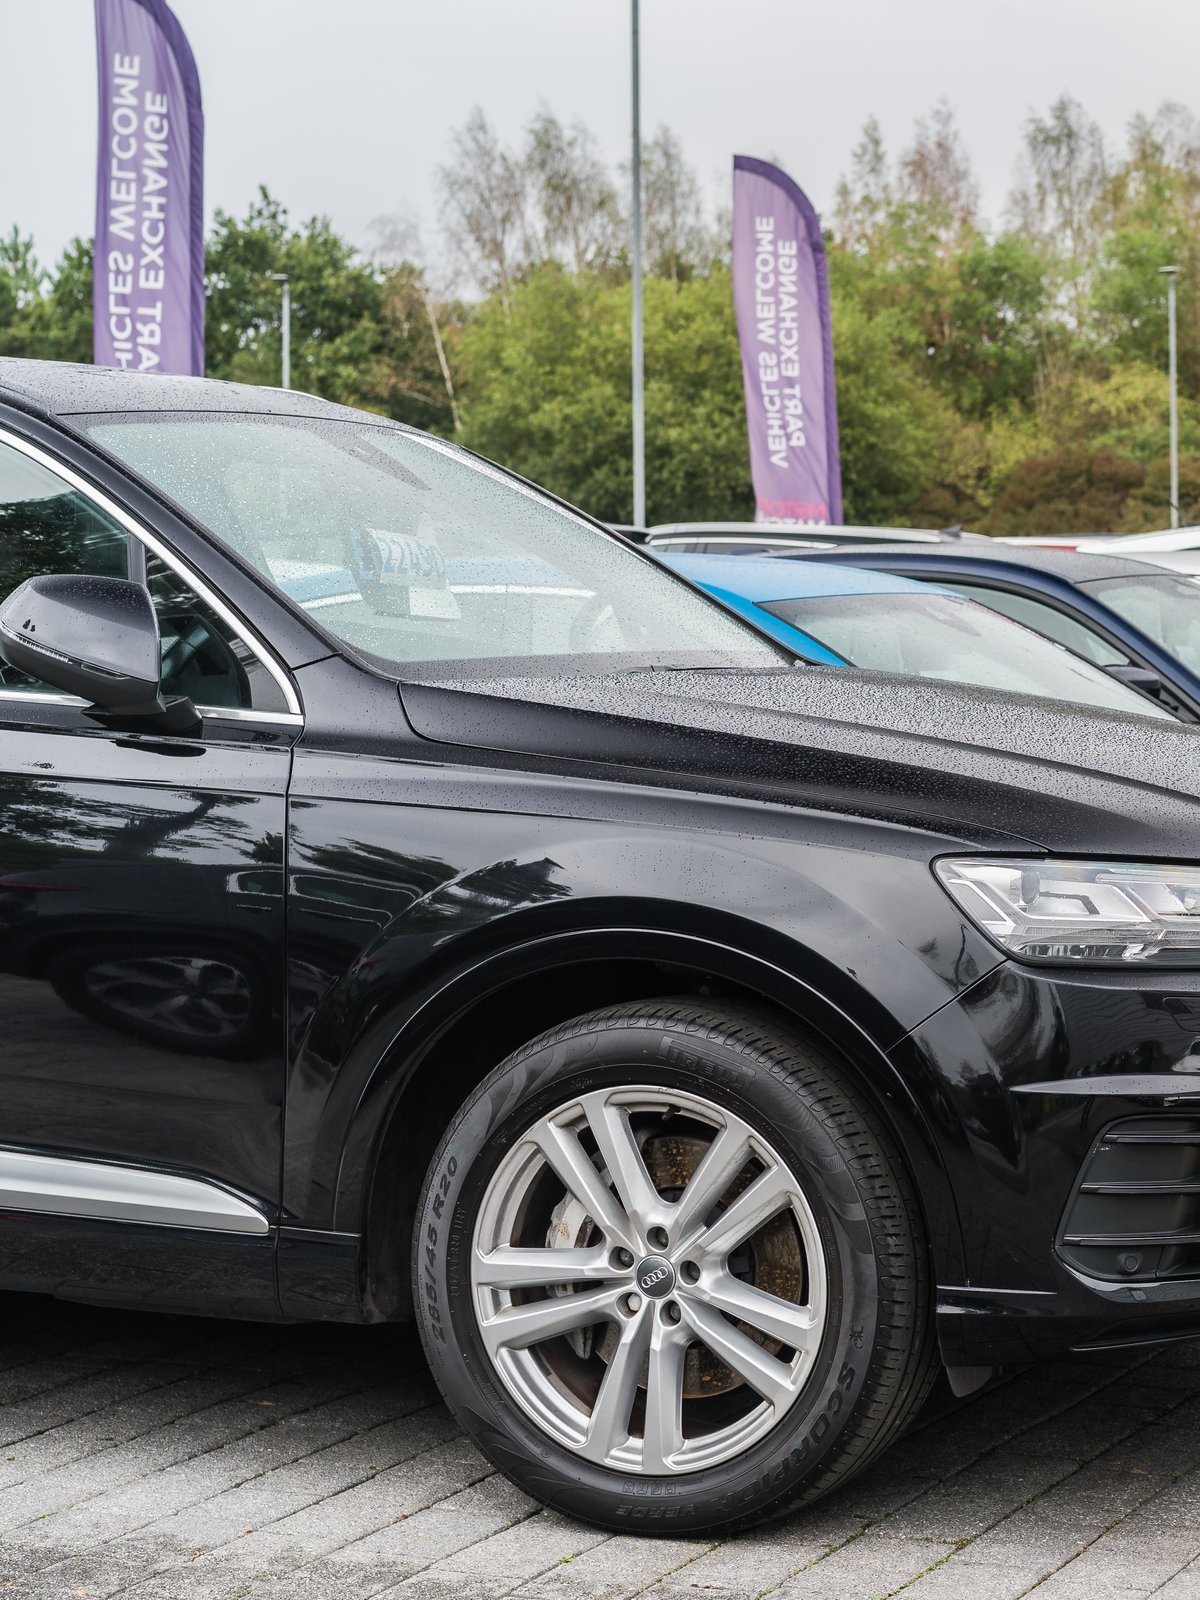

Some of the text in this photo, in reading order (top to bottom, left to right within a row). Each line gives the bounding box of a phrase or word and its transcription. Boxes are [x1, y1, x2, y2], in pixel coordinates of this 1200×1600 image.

[432, 1155, 459, 1221] R20
[425, 1223, 447, 1345] 285/45
[616, 1361, 856, 1519] SCORPION VERDE
